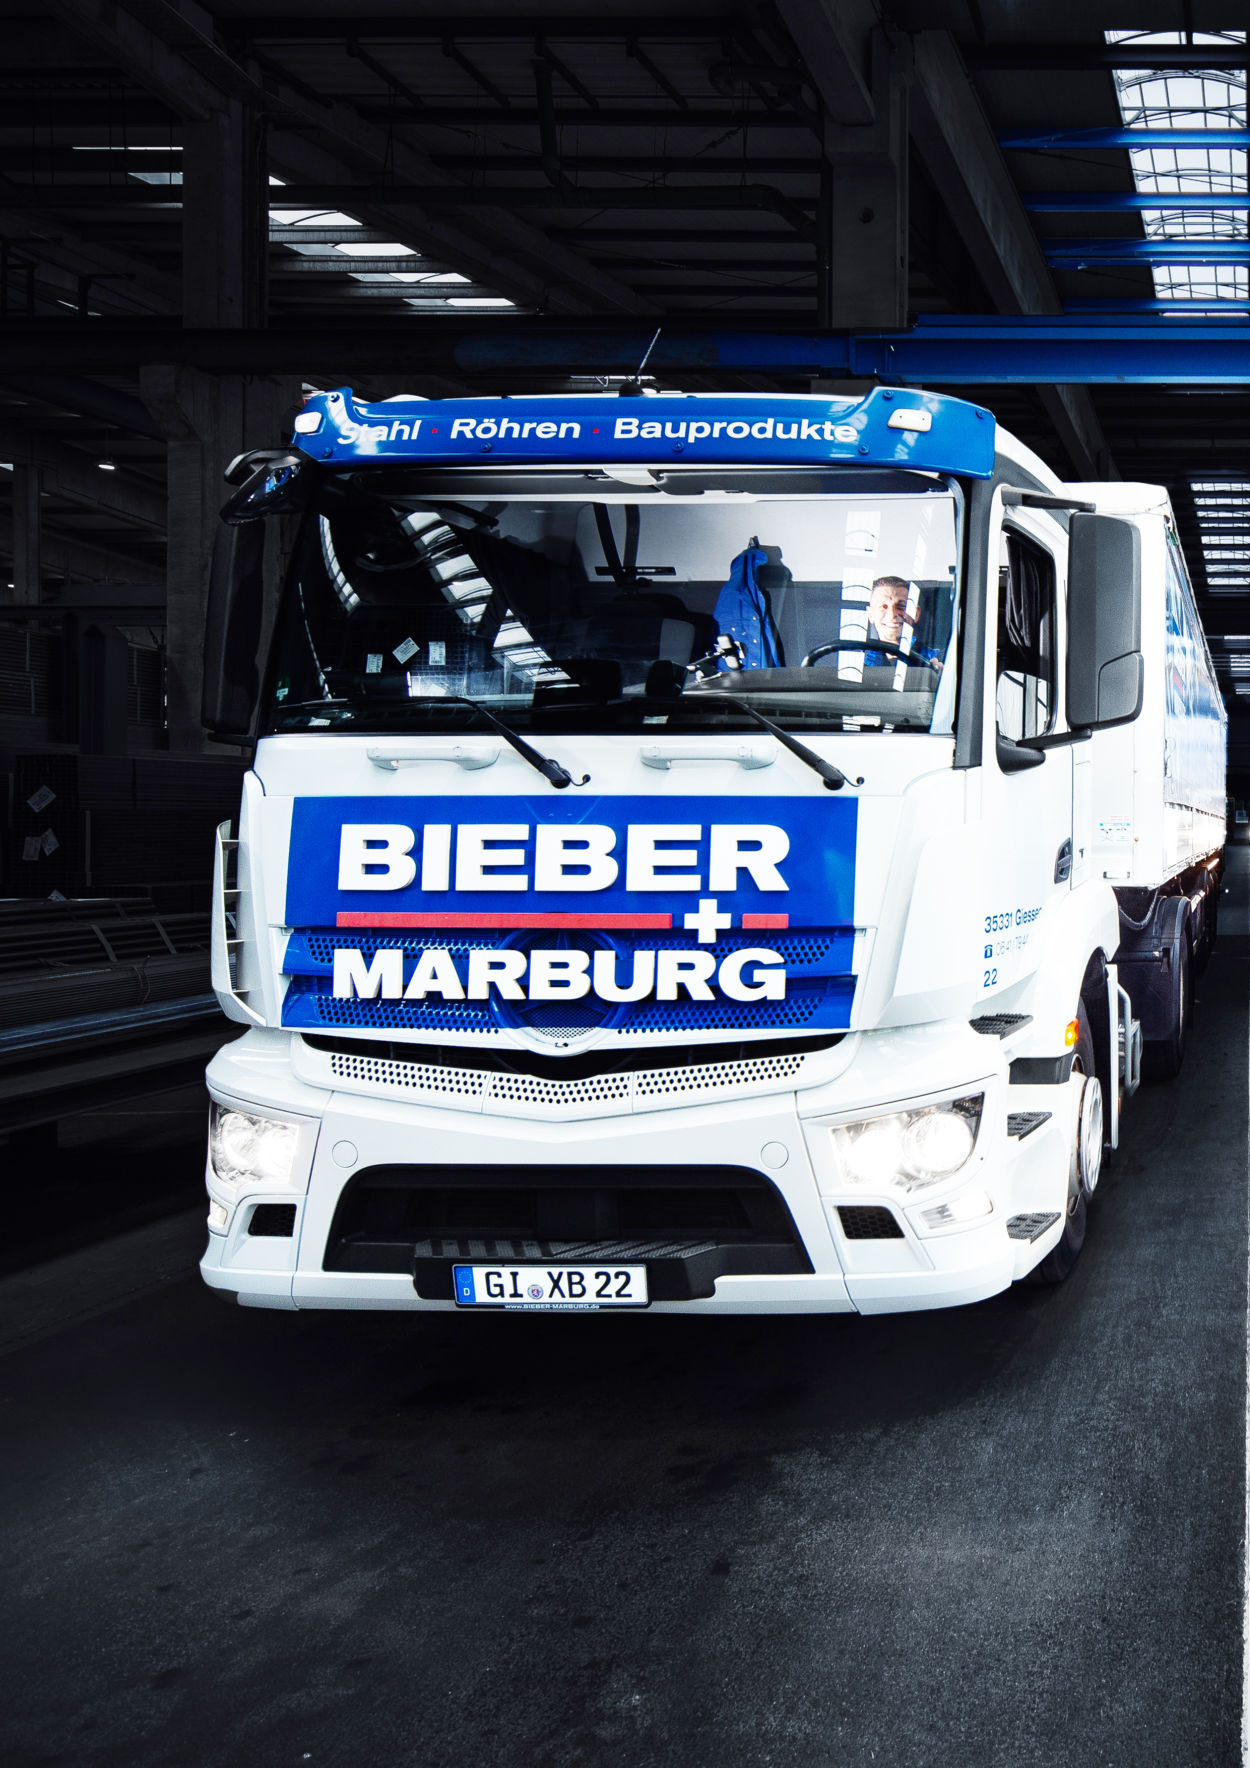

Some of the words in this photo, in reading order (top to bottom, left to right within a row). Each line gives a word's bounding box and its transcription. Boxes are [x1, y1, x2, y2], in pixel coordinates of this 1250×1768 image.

[337, 420, 421, 444] Stahl
[450, 418, 581, 439] Röhren
[613, 417, 858, 443] Bauprodukte
[337, 824, 791, 892] BIEBER
[984, 911, 1013, 933] 35331
[332, 947, 787, 1002] MARBURG
[983, 968, 998, 988] 22
[463, 1287, 471, 1296] D
[485, 1271, 524, 1298] GI
[547, 1271, 587, 1299] XB
[594, 1271, 633, 1298] 22
